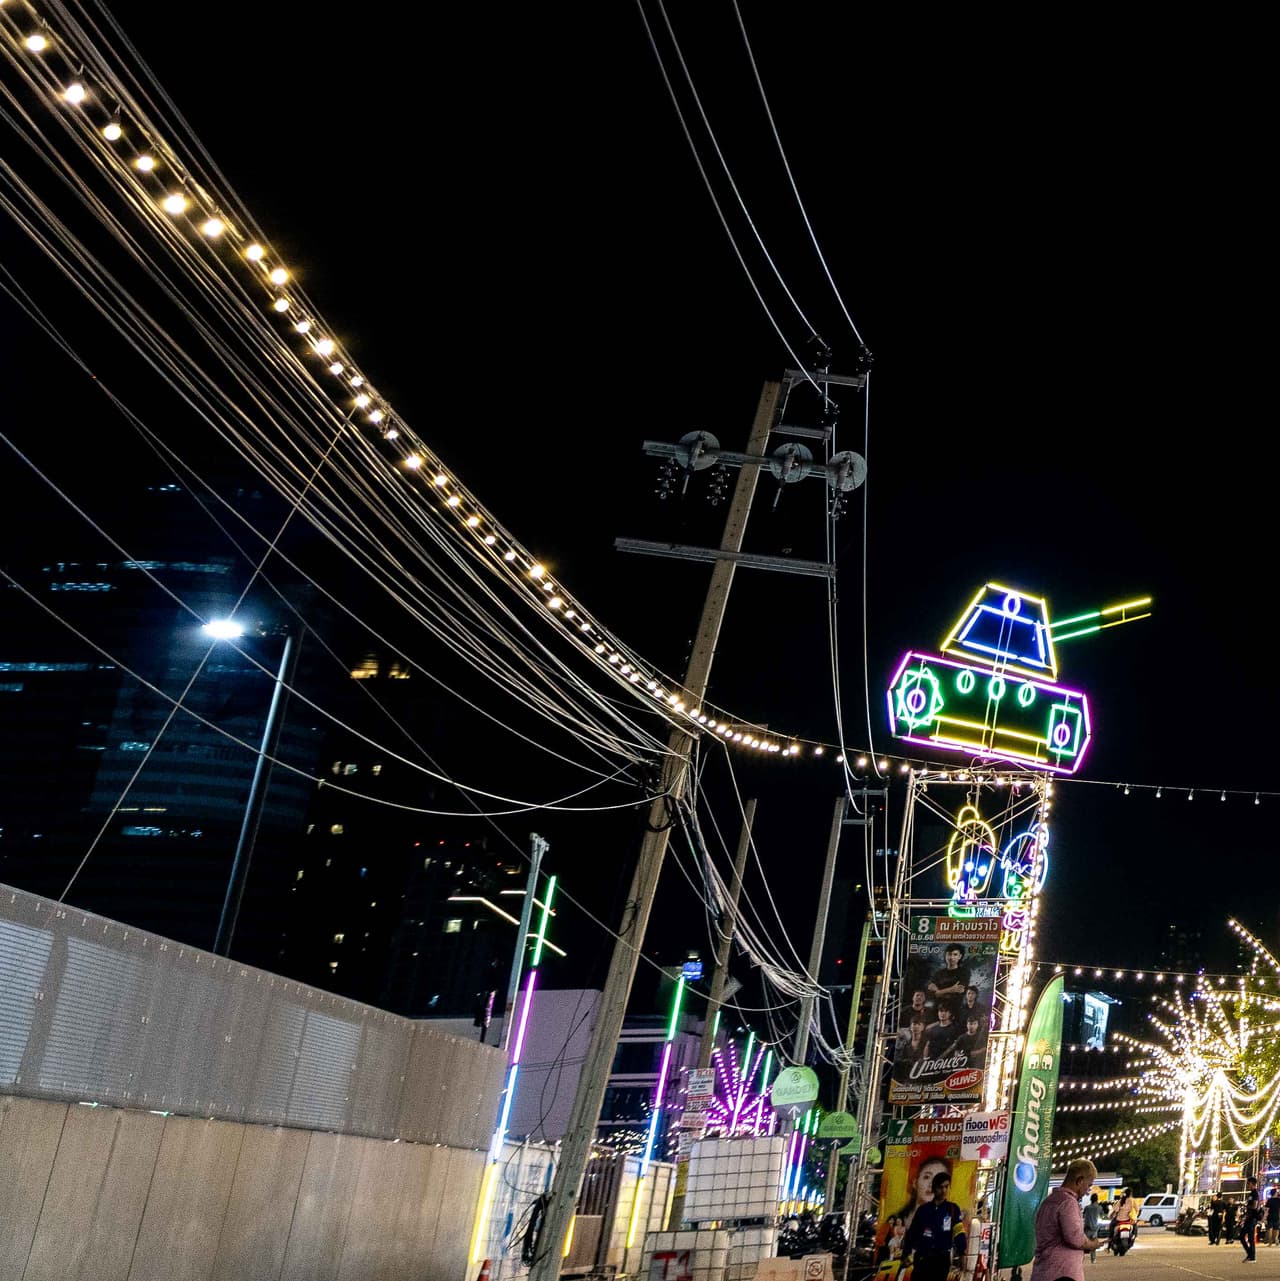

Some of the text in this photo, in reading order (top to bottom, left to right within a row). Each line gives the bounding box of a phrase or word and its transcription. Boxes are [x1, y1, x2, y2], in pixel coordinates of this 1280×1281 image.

[918, 917, 930, 934] 8
[952, 918, 998, 931] ห้างบราโว
[910, 944, 940, 954] Bravo
[896, 1120, 908, 1136] 7
[989, 1113, 1009, 1130] ฟรี
[1013, 1077, 1047, 1192] Chang
